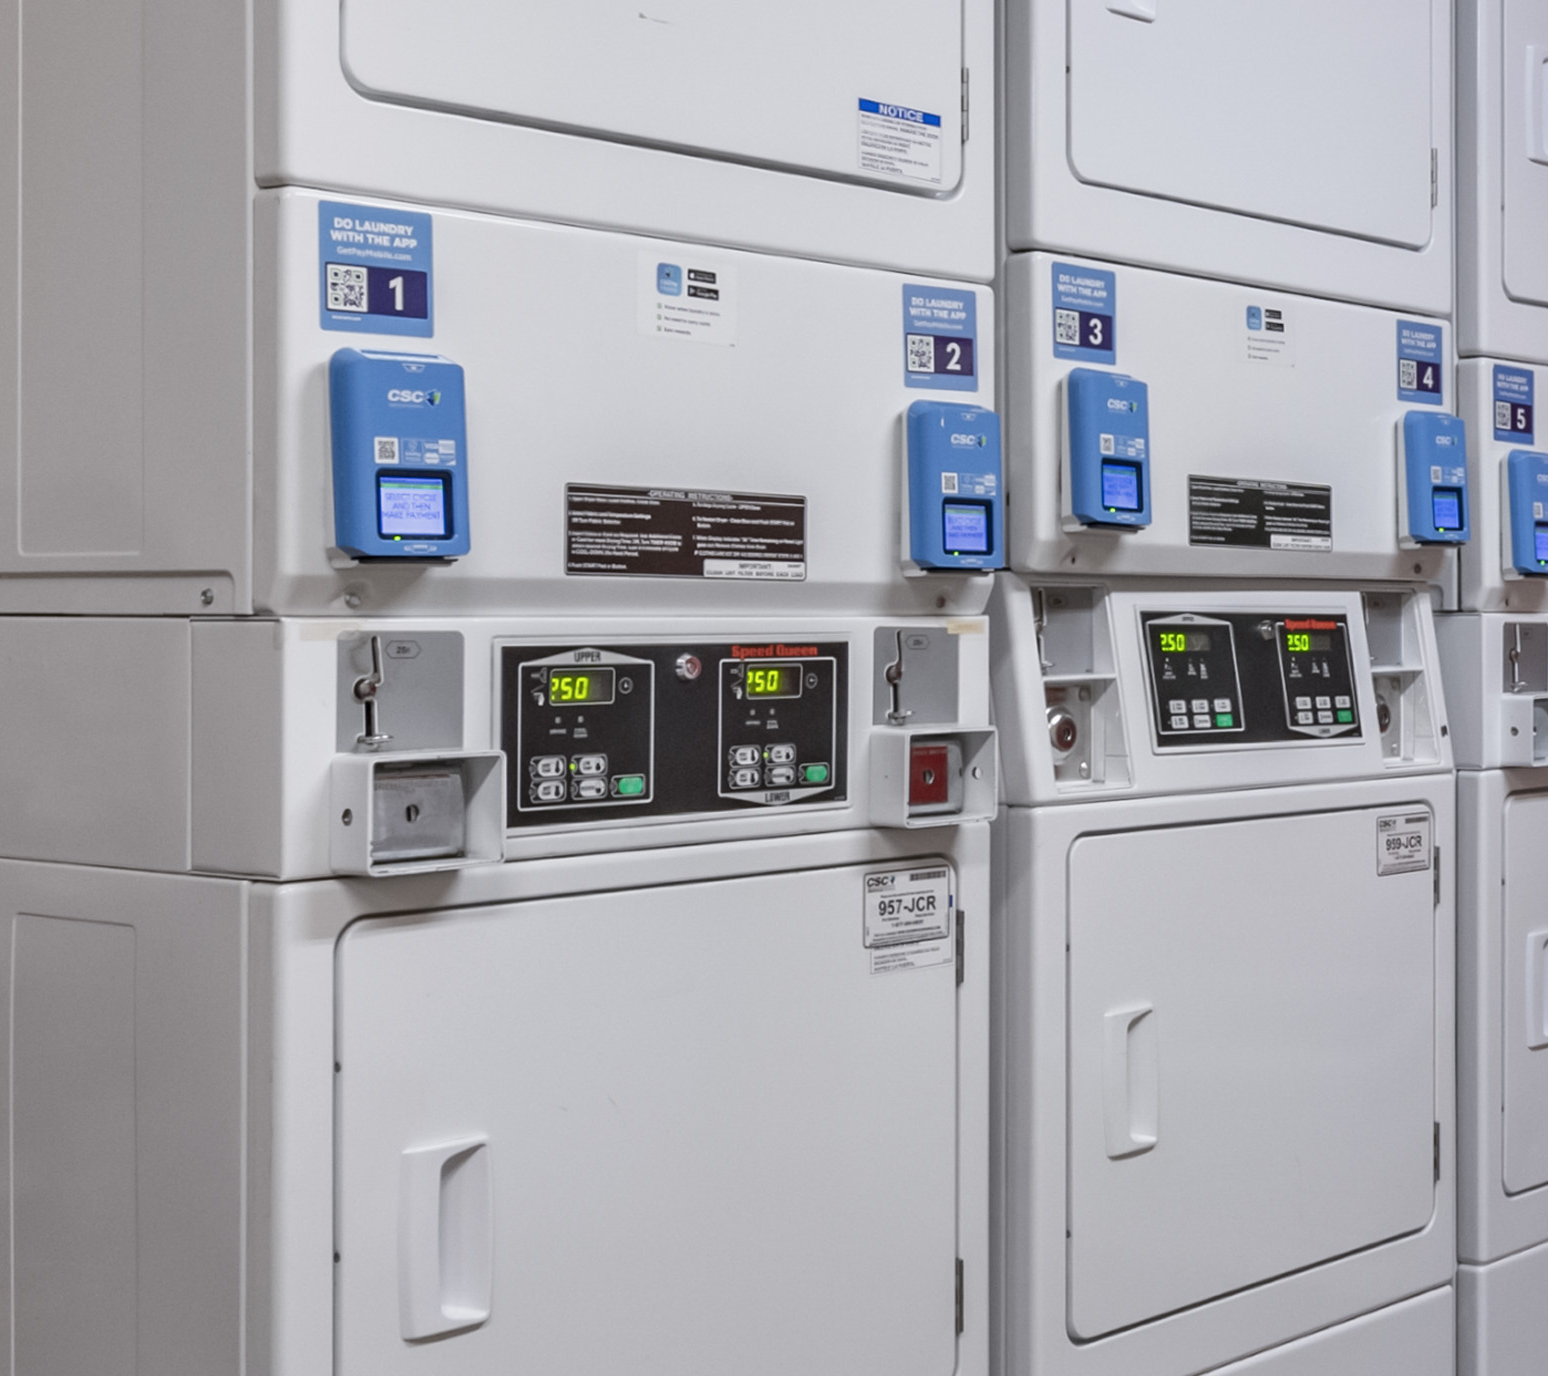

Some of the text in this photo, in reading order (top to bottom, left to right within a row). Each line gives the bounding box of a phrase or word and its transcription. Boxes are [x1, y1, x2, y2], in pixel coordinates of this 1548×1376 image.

[879, 104, 923, 122] NOTICE
[334, 218, 413, 236] DO LAUNDRY
[330, 230, 417, 249] WITH THE APP
[389, 276, 404, 311] 1
[1089, 318, 1102, 345] 3
[946, 343, 961, 370] 2
[1423, 367, 1433, 388] 4
[388, 390, 424, 402] CSC
[1107, 399, 1127, 410] CSC
[1517, 409, 1525, 429] 5
[951, 434, 975, 445] CSC
[574, 652, 601, 662] UPPER
[732, 644, 818, 660] Speed Queen
[765, 792, 790, 802] LOWER
[867, 876, 888, 887] CSC
[879, 895, 936, 916] 957-JCR
